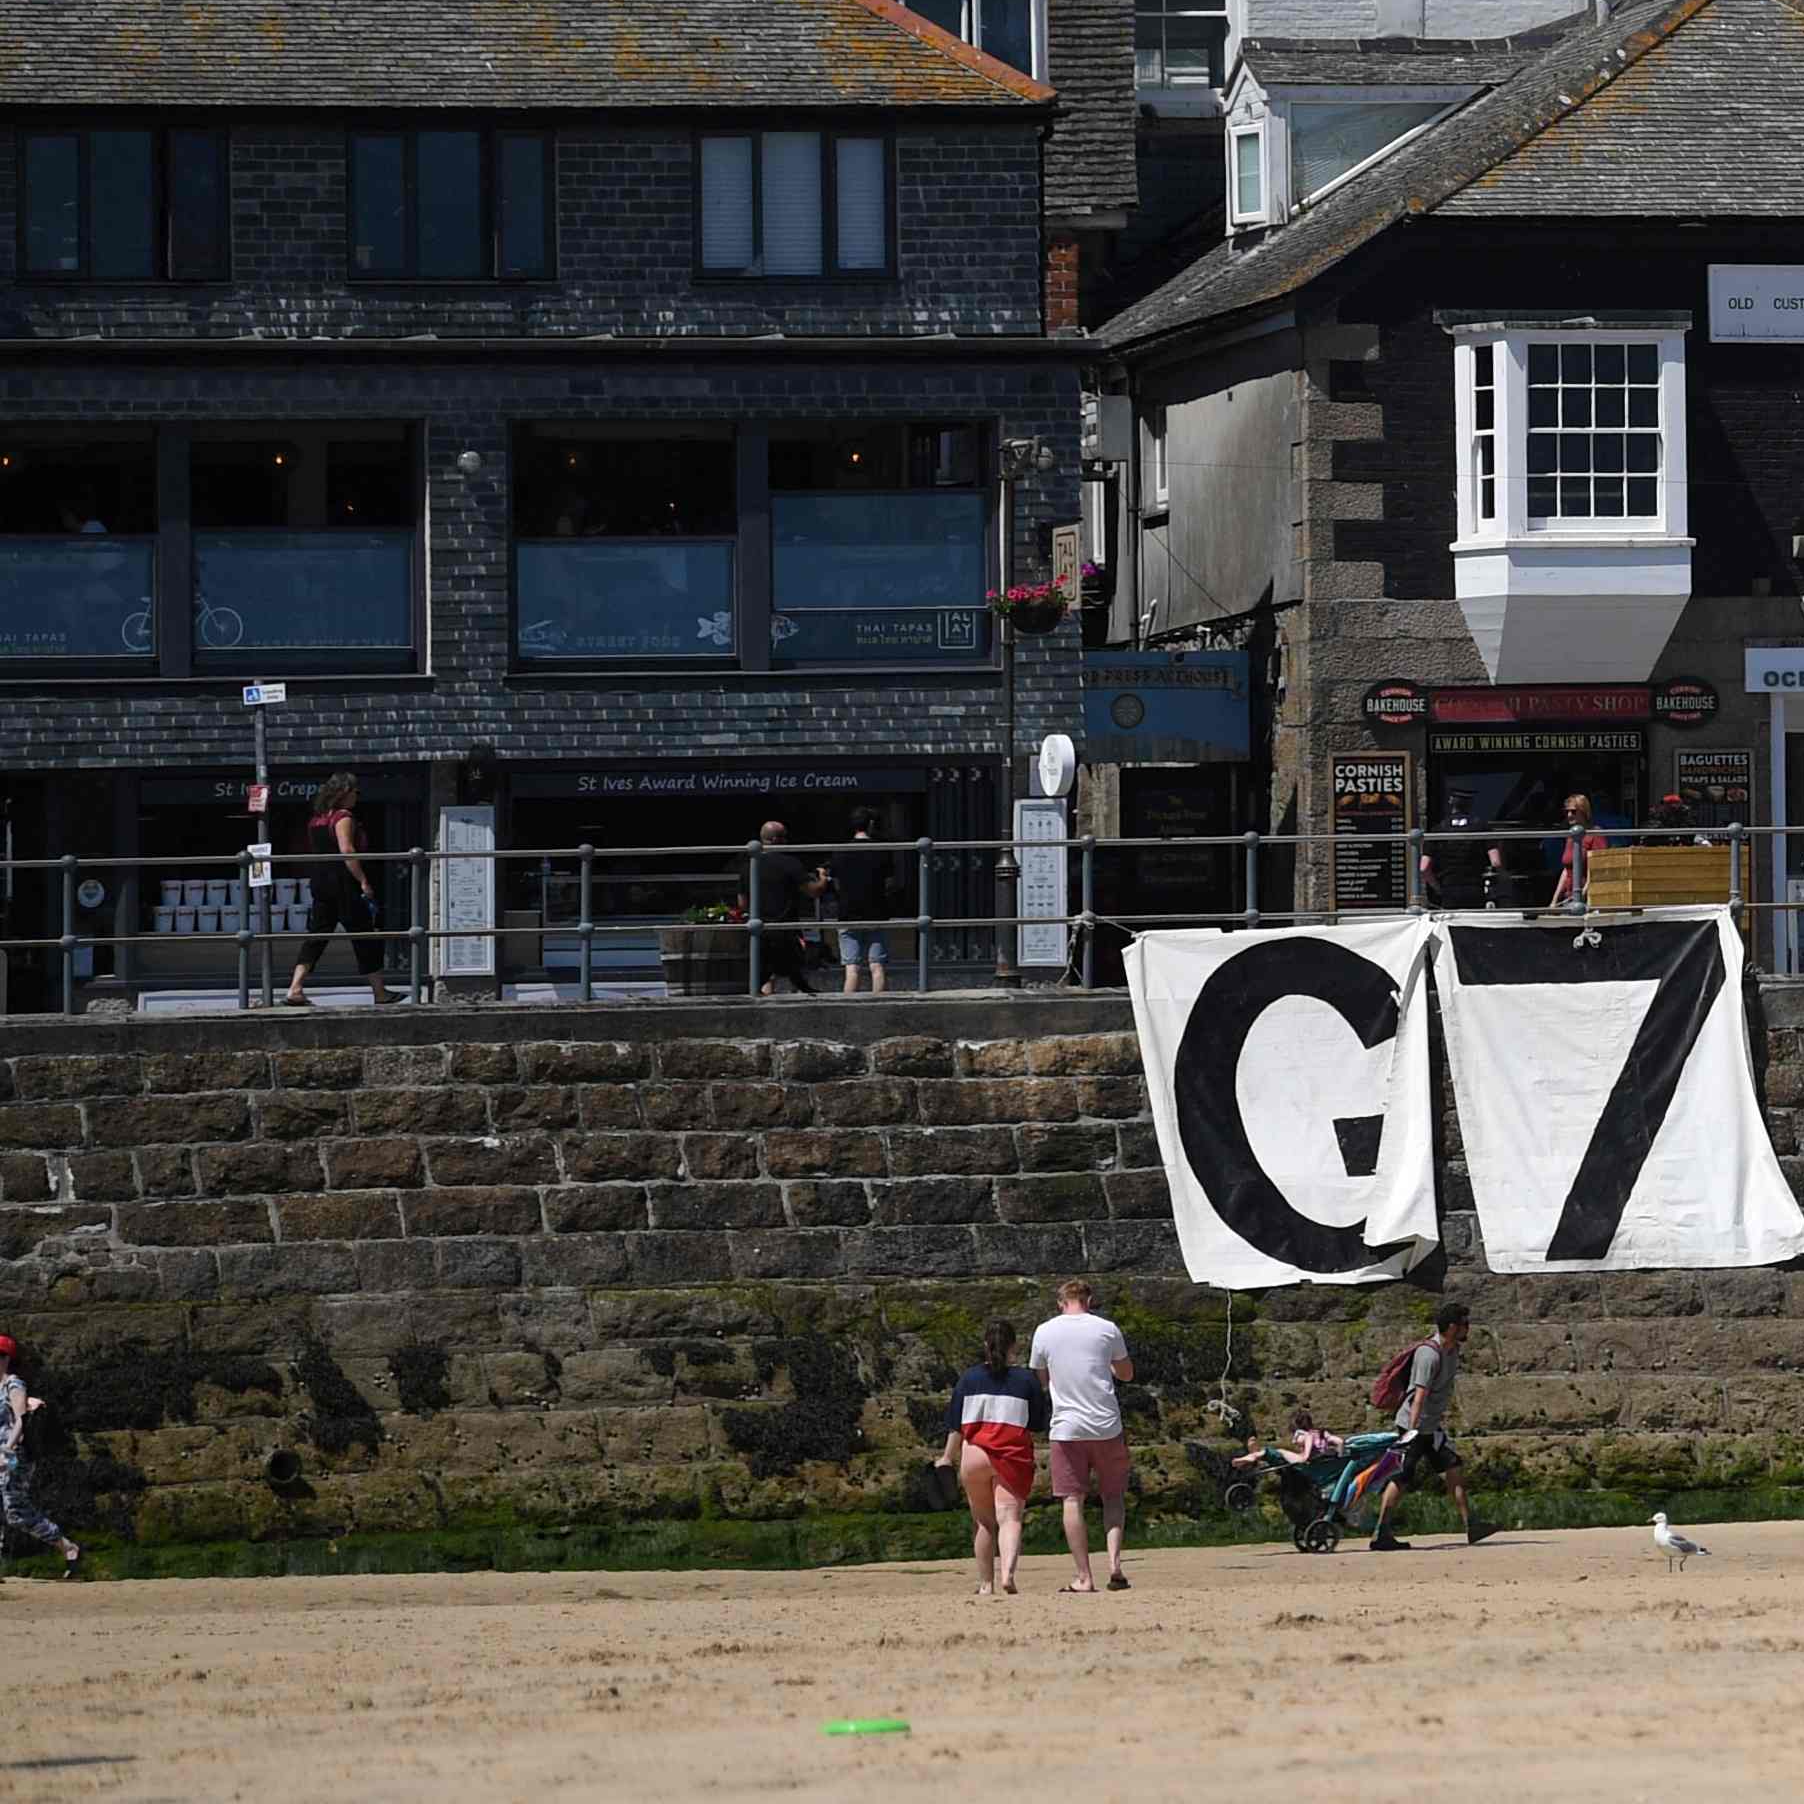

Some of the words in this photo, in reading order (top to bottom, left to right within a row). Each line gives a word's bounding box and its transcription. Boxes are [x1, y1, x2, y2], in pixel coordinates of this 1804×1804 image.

[1728, 297, 1755, 310] OLD
[1366, 697, 1426, 714] BAKEHOUSE
[1592, 693, 1645, 710] SHOP
[1656, 694, 1716, 711] BAKEHOUSE
[1434, 736, 1475, 750] AWARD
[1480, 736, 1531, 750] WINNING
[1534, 735, 1586, 749] CORNISH
[1589, 734, 1638, 749] PASTIES
[1679, 754, 1749, 766] BAGUETTES
[1335, 764, 1404, 778] CORNISH
[214, 779, 233, 798] St
[577, 773, 599, 792] St
[602, 773, 634, 792] Ives
[638, 773, 696, 792] Award
[702, 773, 772, 795] Winning
[775, 773, 799, 790] Ice
[803, 773, 859, 789] Cream
[1335, 777, 1404, 794] PASTIES
[1175, 920, 1726, 1273] G7
